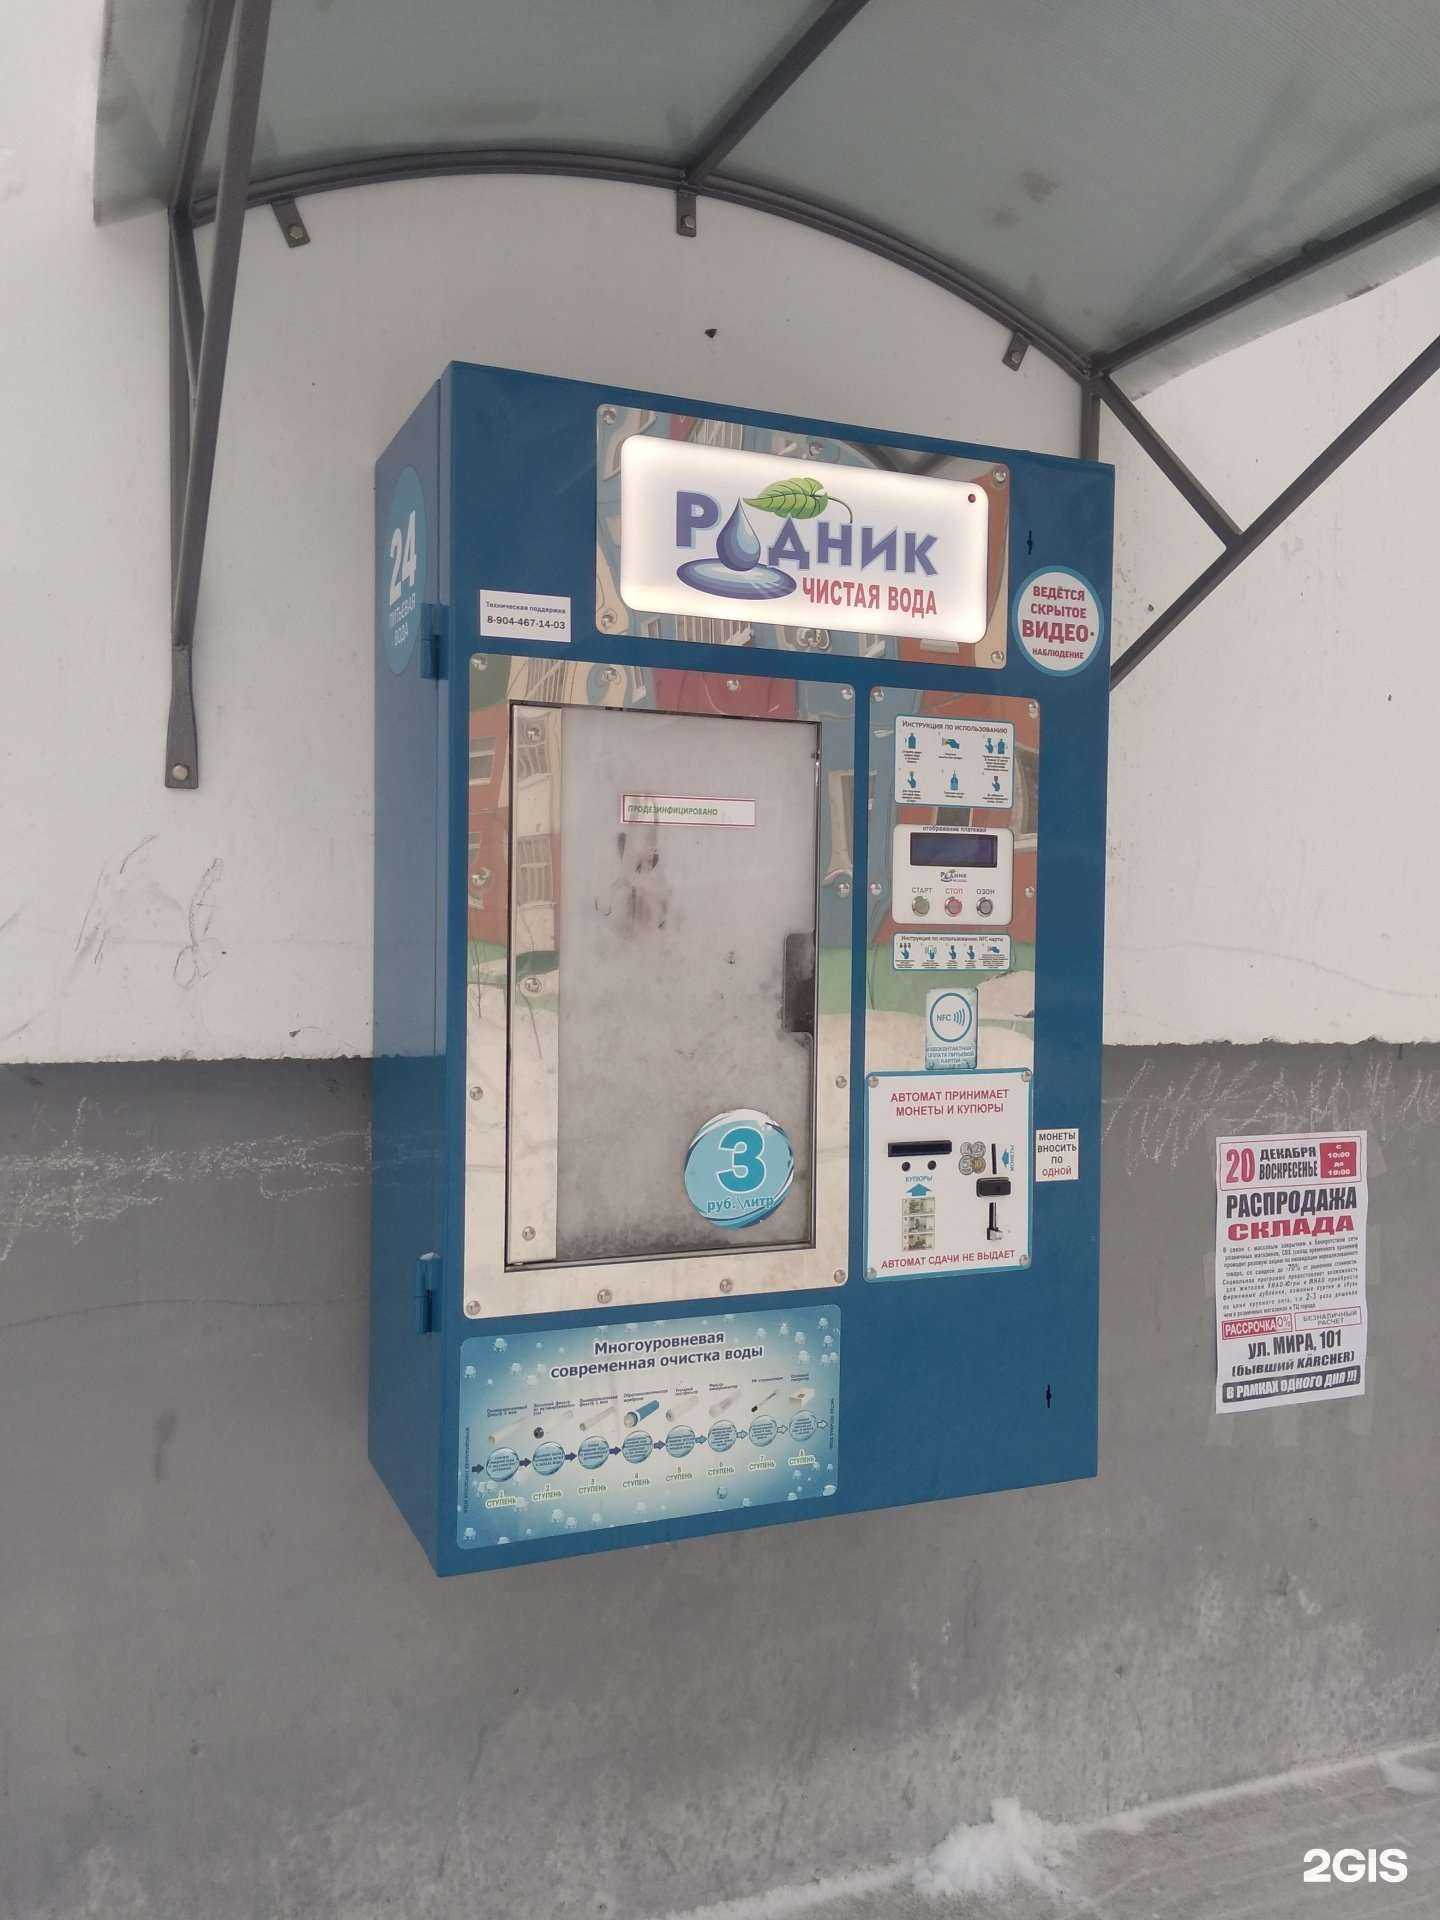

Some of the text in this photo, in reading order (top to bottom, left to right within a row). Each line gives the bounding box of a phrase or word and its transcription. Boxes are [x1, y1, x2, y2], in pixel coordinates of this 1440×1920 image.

[389, 510, 416, 607] 24
[802, 577, 938, 618] ЧИСТАЯ ВОДА
[1033, 585, 1085, 601] ВЕДЁТСЯ
[1030, 603, 1087, 618] СКРЫТОЕ
[487, 615, 566, 630] 8-904-467-14-03
[1032, 648, 1085, 659] НАБЛЮДЕНИЕ
[628, 804, 718, 816] ПРОДЕЗИНФИЦИРОВАНО
[936, 1014, 952, 1022] NFC
[891, 1089, 1010, 1102] АВТОМАТ ПРИНИМАЕТ
[896, 1103, 1004, 1116] МОНЕТЫ И КУПЮРЫ
[1039, 1132, 1076, 1141] МОНЕТЫ
[1037, 1144, 1077, 1153] ВНОСИТЬ
[1260, 1146, 1317, 1162] ДЕКАБРЯ
[717, 1126, 767, 1194] 3
[1051, 1156, 1063, 1164] ПО
[1226, 1148, 1256, 1184] 20
[1041, 1166, 1072, 1178] ОДНОЙ
[1259, 1160, 1318, 1181] ВОСКРЕСЕНЬЕ
[905, 1175, 933, 1183] КУПЮРЫ
[1226, 1186, 1357, 1218] РАСПРОДАЖА
[1228, 1215, 1354, 1241] СКЛАДА
[881, 1249, 1016, 1269] АВТОМАТ СДАЧИ НЕ ВЫДАЕТ
[1225, 1318, 1276, 1337] РАССРОЧКА
[1317, 1318, 1344, 1326] РАСЧЕТ
[594, 1332, 724, 1355] Многоуровневая
[1273, 1333, 1317, 1355] МИРА,
[1320, 1329, 1342, 1349] 101
[551, 1346, 763, 1379] современная очистка воды
[1226, 1386, 1235, 1399] В
[1236, 1380, 1279, 1397] РАМКАХ
[1281, 1375, 1323, 1392] ОДНОГО
[1324, 1372, 1346, 1388] ДНЯ
[749, 1462, 775, 1470] СТУПЕНЬ
[789, 1457, 815, 1465] СТУПЕНЬ
[665, 1474, 692, 1482] СТУПЕНЬ
[708, 1467, 735, 1476] СТУПЕНЬ
[578, 1485, 607, 1494] СТУПЕНЬ
[622, 1479, 650, 1488] СТУПЕНЬ
[486, 1497, 517, 1507] СТУПЕНЬ
[533, 1491, 562, 1500] СТУПЕНЬ
